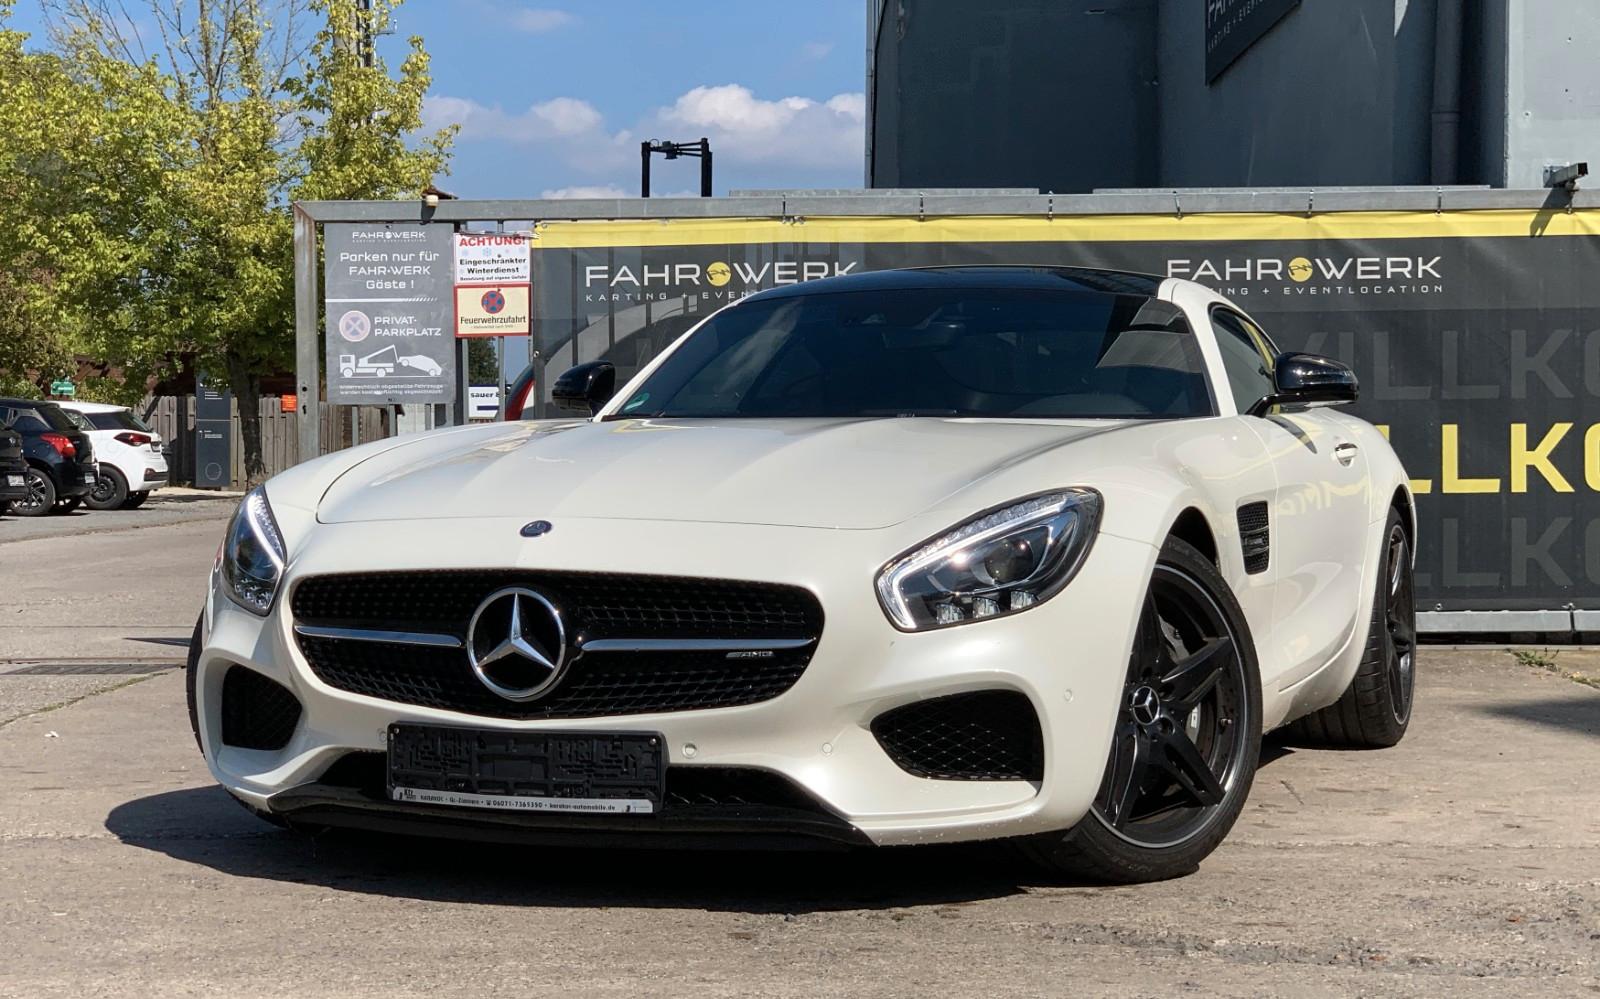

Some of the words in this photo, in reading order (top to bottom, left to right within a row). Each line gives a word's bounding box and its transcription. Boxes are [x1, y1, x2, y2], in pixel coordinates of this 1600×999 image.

[459, 235, 526, 247] ACHTUNG!
[340, 251, 388, 262] Parken
[392, 253, 415, 262] nur
[419, 250, 440, 262] für
[459, 257, 527, 266] Eingeschränkter
[366, 280, 406, 290] Gäste
[1283, 285, 1443, 295] EVENTLOCATION
[585, 291, 668, 303] KARTING
[460, 315, 527, 325] Feuerwehrzufahrt
[374, 327, 442, 337] PARKPLATZ
